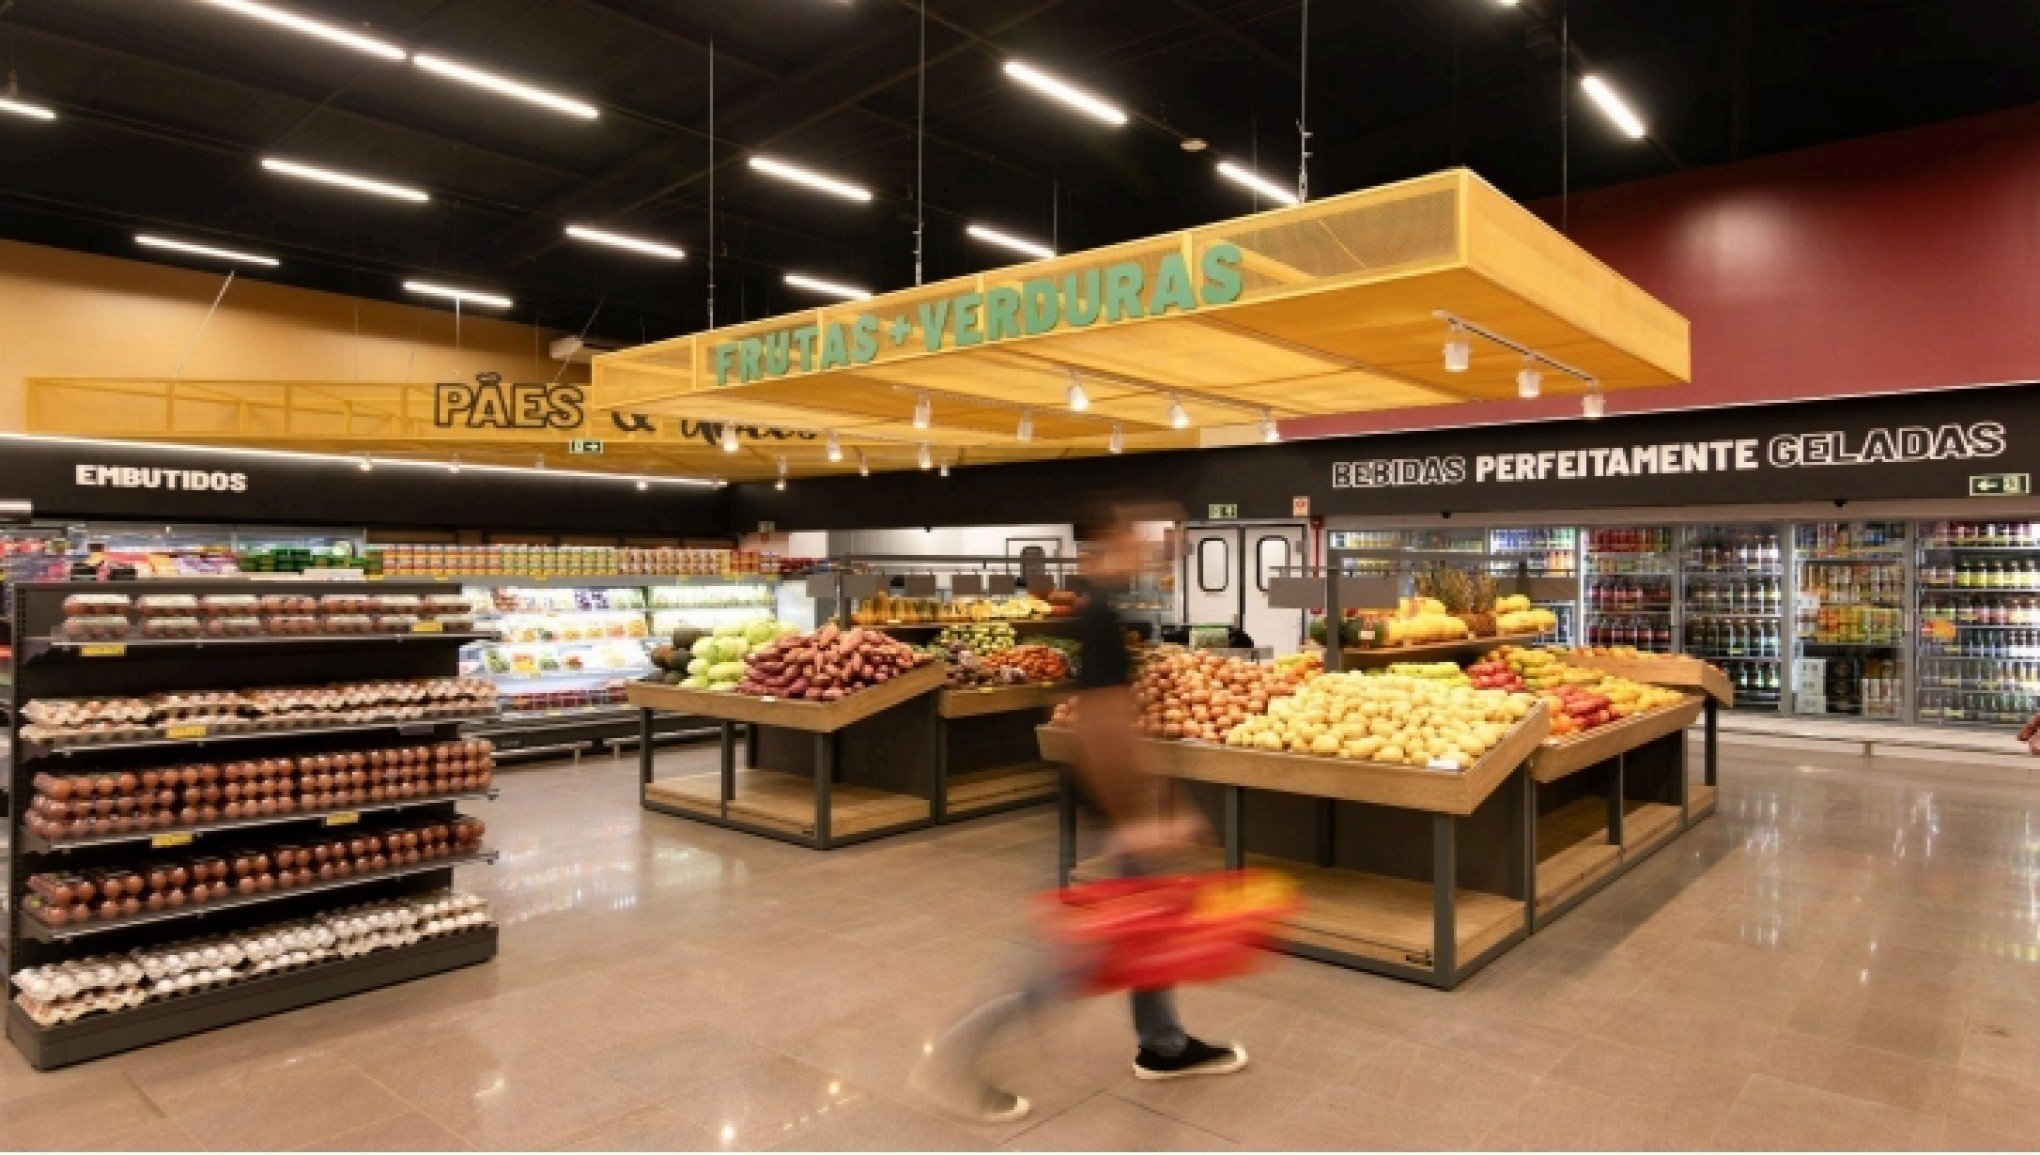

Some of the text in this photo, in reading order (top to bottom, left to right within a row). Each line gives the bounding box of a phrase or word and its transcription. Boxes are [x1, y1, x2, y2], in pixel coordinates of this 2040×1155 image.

[715, 243, 1244, 387] FRUTAS + VERDURAS
[434, 371, 584, 429] PÃES
[75, 464, 248, 493] EMBUTIDOS
[1331, 421, 2007, 489] BEBIDAS PERFEITAMENTE GELADAS
